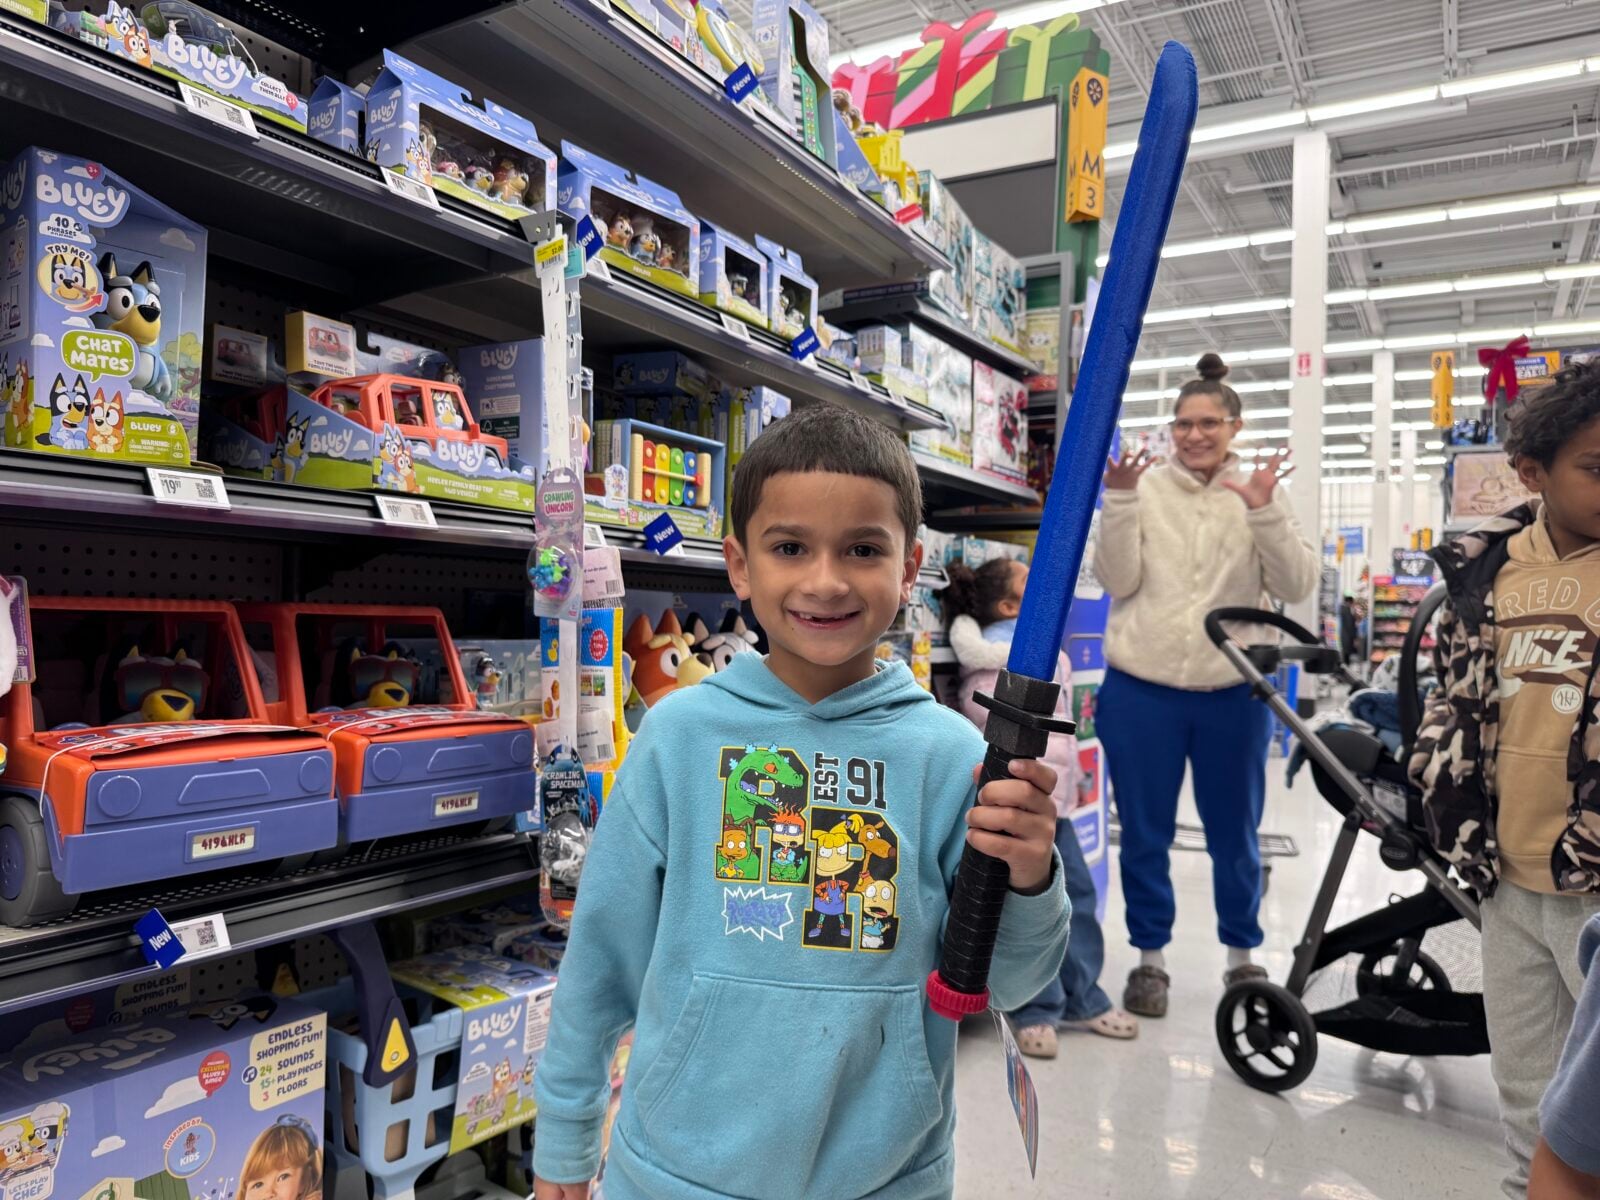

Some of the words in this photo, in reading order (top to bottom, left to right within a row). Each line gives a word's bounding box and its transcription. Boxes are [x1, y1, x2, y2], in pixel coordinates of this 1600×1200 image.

[168, 33, 246, 89] BLUEY
[260, 80, 282, 93] COLLECT
[732, 73, 752, 94] New
[310, 107, 336, 130] BLUEY
[371, 100, 397, 124] BLUEY
[1082, 150, 1101, 179] M
[36, 174, 126, 223] BLUEY
[1086, 186, 1096, 209] 3
[55, 216, 70, 229] 10
[47, 245, 68, 254] TRY
[76, 335, 123, 353] CHAT
[797, 335, 817, 352] New
[70, 350, 129, 372] MATES
[480, 344, 518, 370] BLUEY
[310, 429, 352, 457] BLUEY
[436, 437, 486, 473] BLUEY
[543, 490, 575, 504] CRAWLING
[545, 502, 574, 514] UNICORN
[653, 525, 675, 544] New
[1497, 576, 1581, 620] RED
[1503, 629, 1587, 668] NIKE
[545, 770, 581, 780] CRAWLING
[550, 779, 585, 789] SPACEMAN
[813, 751, 840, 804] EST
[846, 757, 888, 811] 91
[148, 928, 173, 951] New
[133, 973, 177, 993] ENDLESS
[122, 989, 164, 1007] SHOPPING
[142, 998, 179, 1016] SOUNDS
[268, 1022, 313, 1045] ENDLESS
[468, 1004, 522, 1041] BLUEY
[256, 1039, 301, 1061] SHOPPING
[301, 1030, 324, 1047] FUN!
[259, 1064, 273, 1078] 24
[277, 1050, 315, 1071] SOUNDS
[262, 1091, 270, 1102] 3
[276, 1077, 308, 1097] FLOORS
[180, 1151, 201, 1167] KIDS
[13, 1183, 44, 1200] CHEF
[30, 1176, 49, 1188] PLAY
